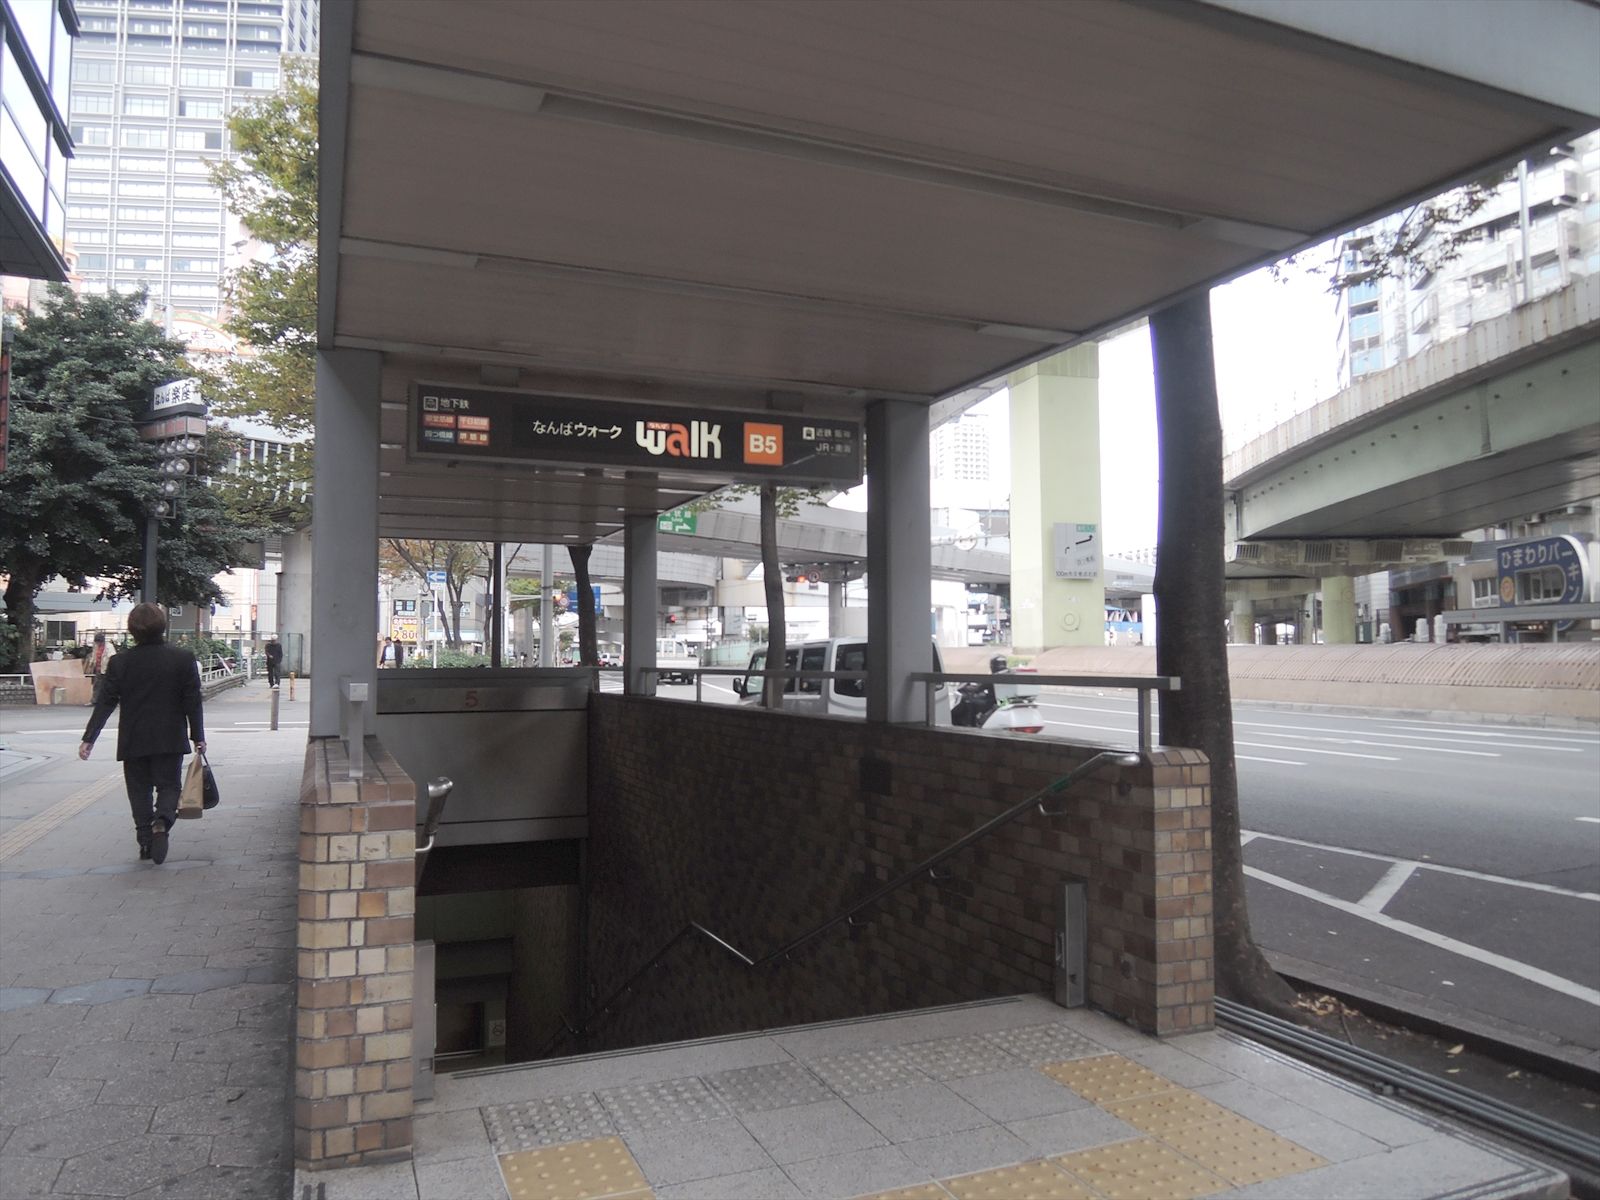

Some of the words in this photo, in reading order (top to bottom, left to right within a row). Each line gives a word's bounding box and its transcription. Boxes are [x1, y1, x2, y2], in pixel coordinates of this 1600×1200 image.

[440, 398, 470, 410] 地下鉄
[532, 419, 623, 440] なんばウォーク
[749, 433, 778, 454] B5
[464, 690, 480, 708] 5
